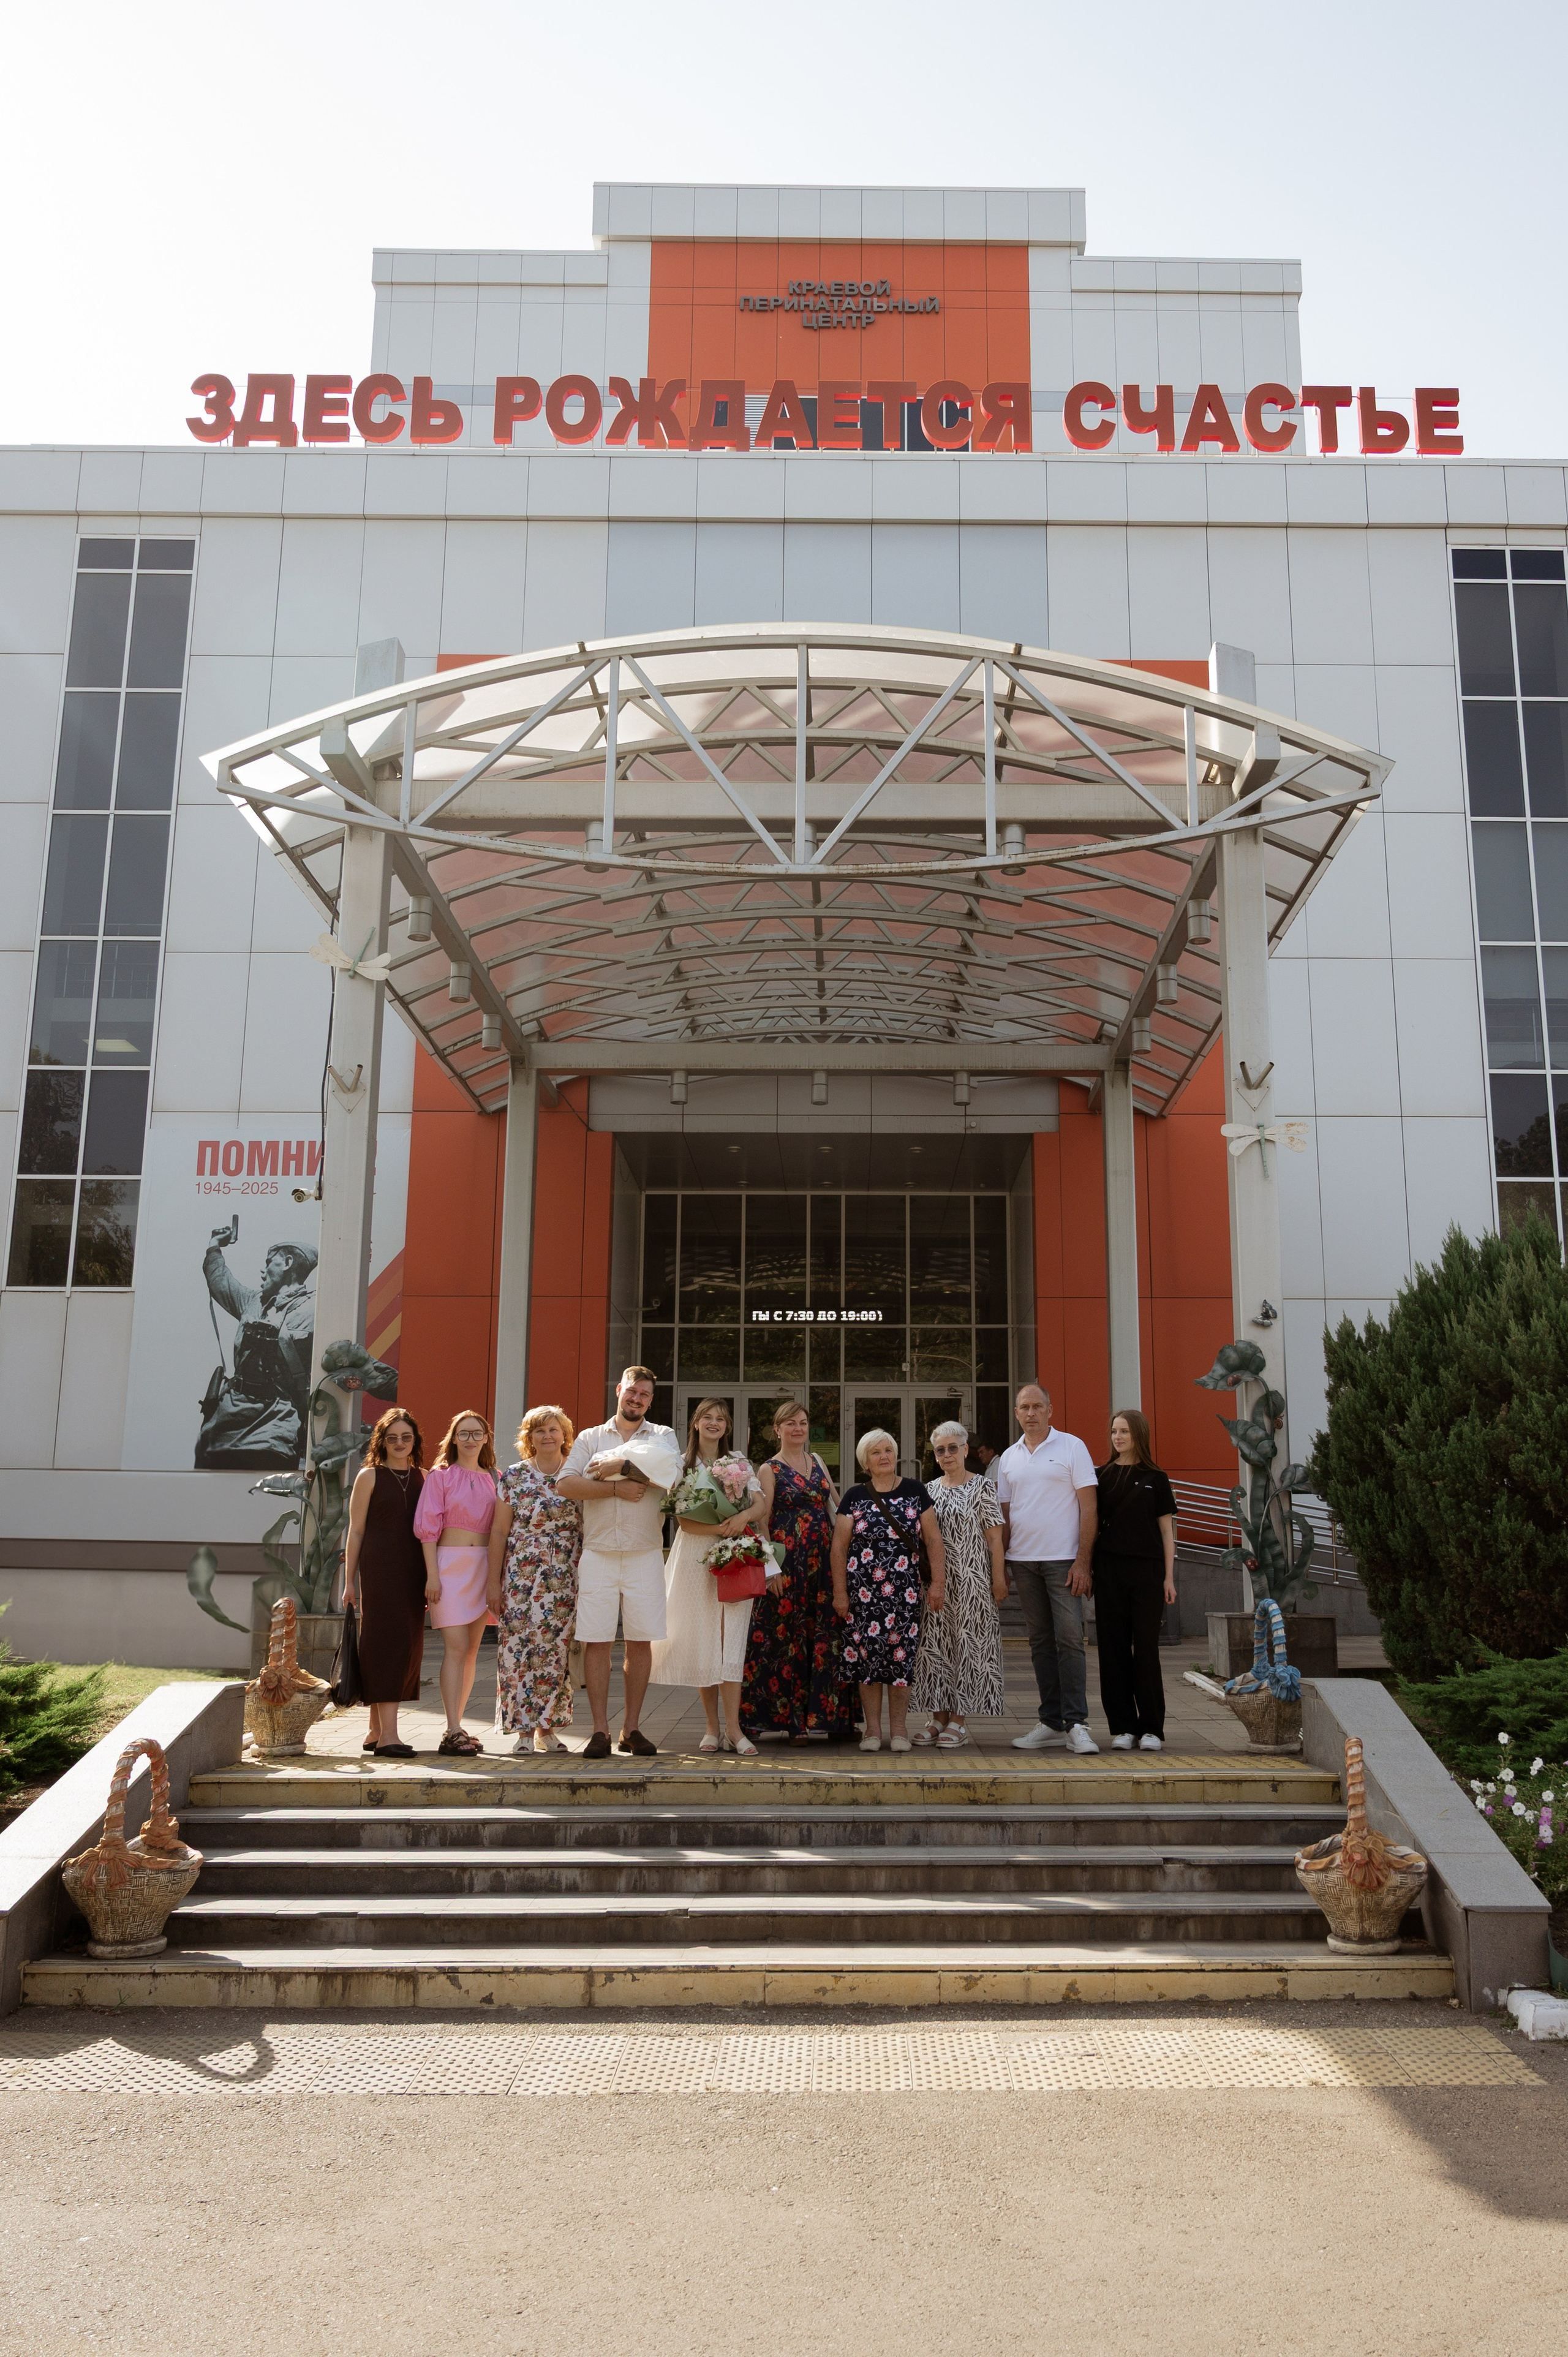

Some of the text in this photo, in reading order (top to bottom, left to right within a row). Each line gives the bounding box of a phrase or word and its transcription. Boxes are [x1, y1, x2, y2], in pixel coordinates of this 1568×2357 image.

[788, 279, 891, 296] КРАЕВОЙ
[739, 296, 940, 313] ПЕРИНАТАЛЬНЫЙ
[802, 312, 875, 330] ЦЕНТР
[186, 373, 1464, 455] ЗДЕСЬ РОЖДАЕТСЯ СЧАСТЬЕ
[196, 1140, 377, 1176] ПОМНИ
[773, 1310, 782, 1321] С
[785, 1310, 814, 1321] 7:30
[816, 1310, 837, 1321] ДО
[840, 1310, 883, 1321] 19:00)
